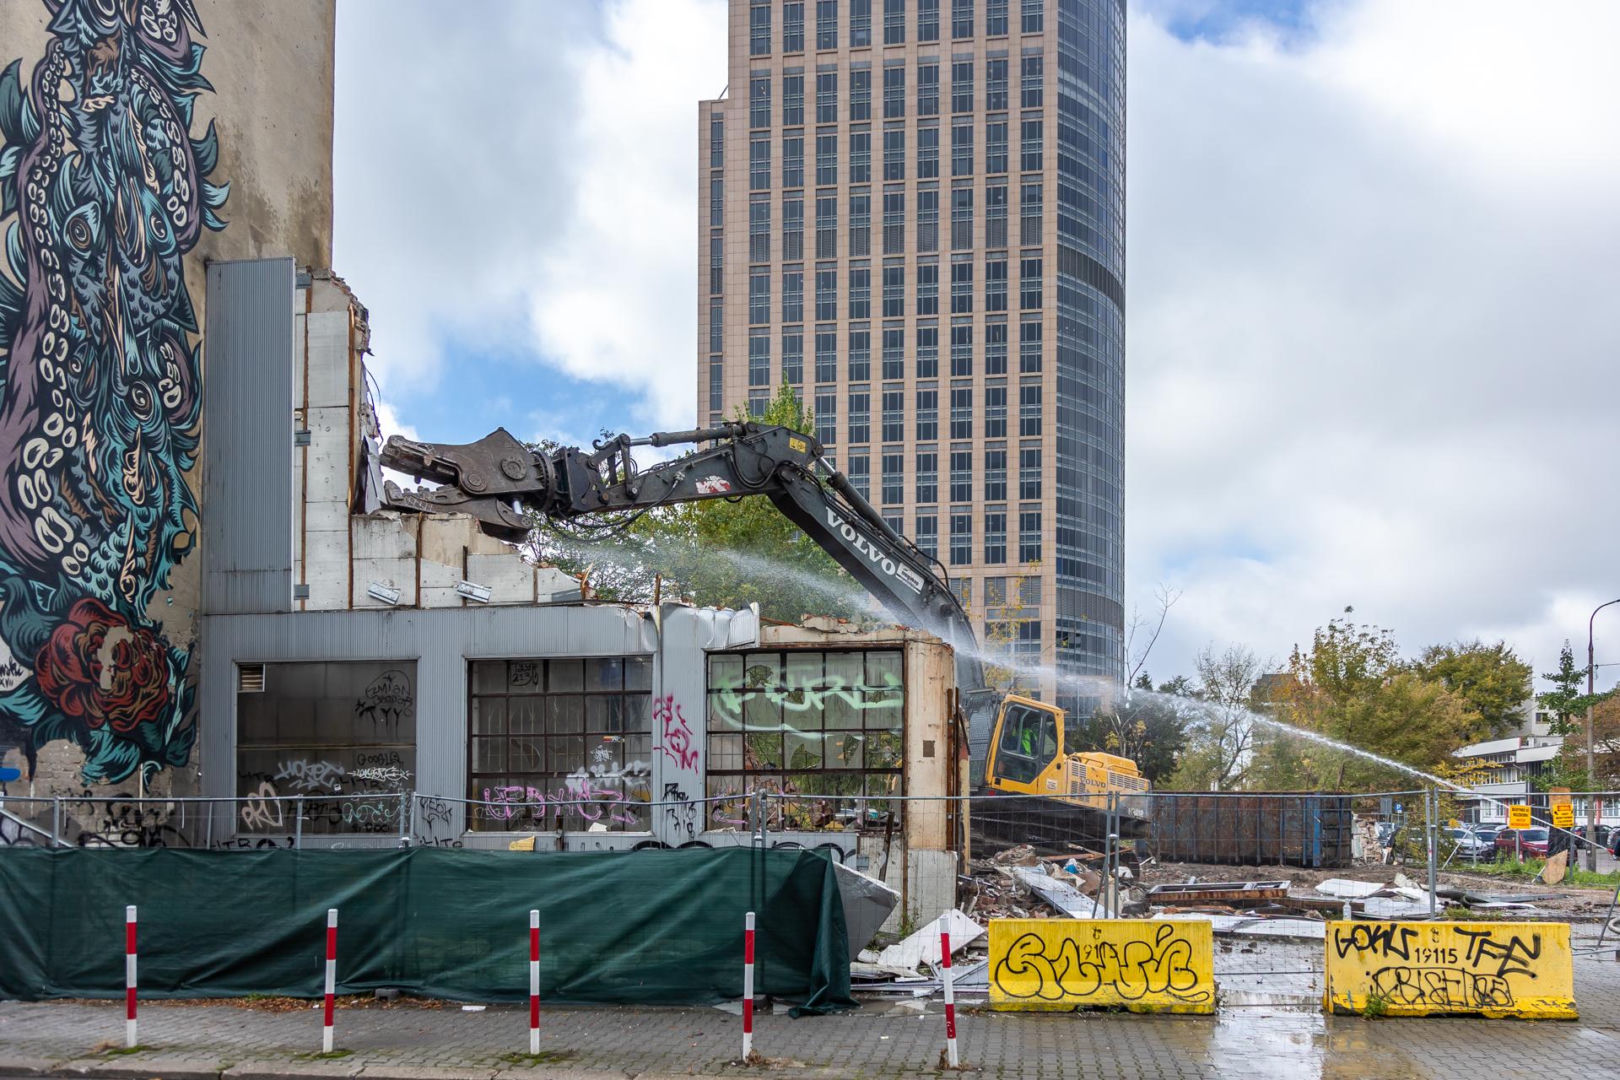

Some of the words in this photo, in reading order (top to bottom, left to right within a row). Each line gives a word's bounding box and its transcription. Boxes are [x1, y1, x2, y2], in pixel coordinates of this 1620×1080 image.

[825, 506, 896, 577] VOLVO
[1080, 776, 1107, 789] VOLVO
[1414, 947, 1458, 964] 19115
